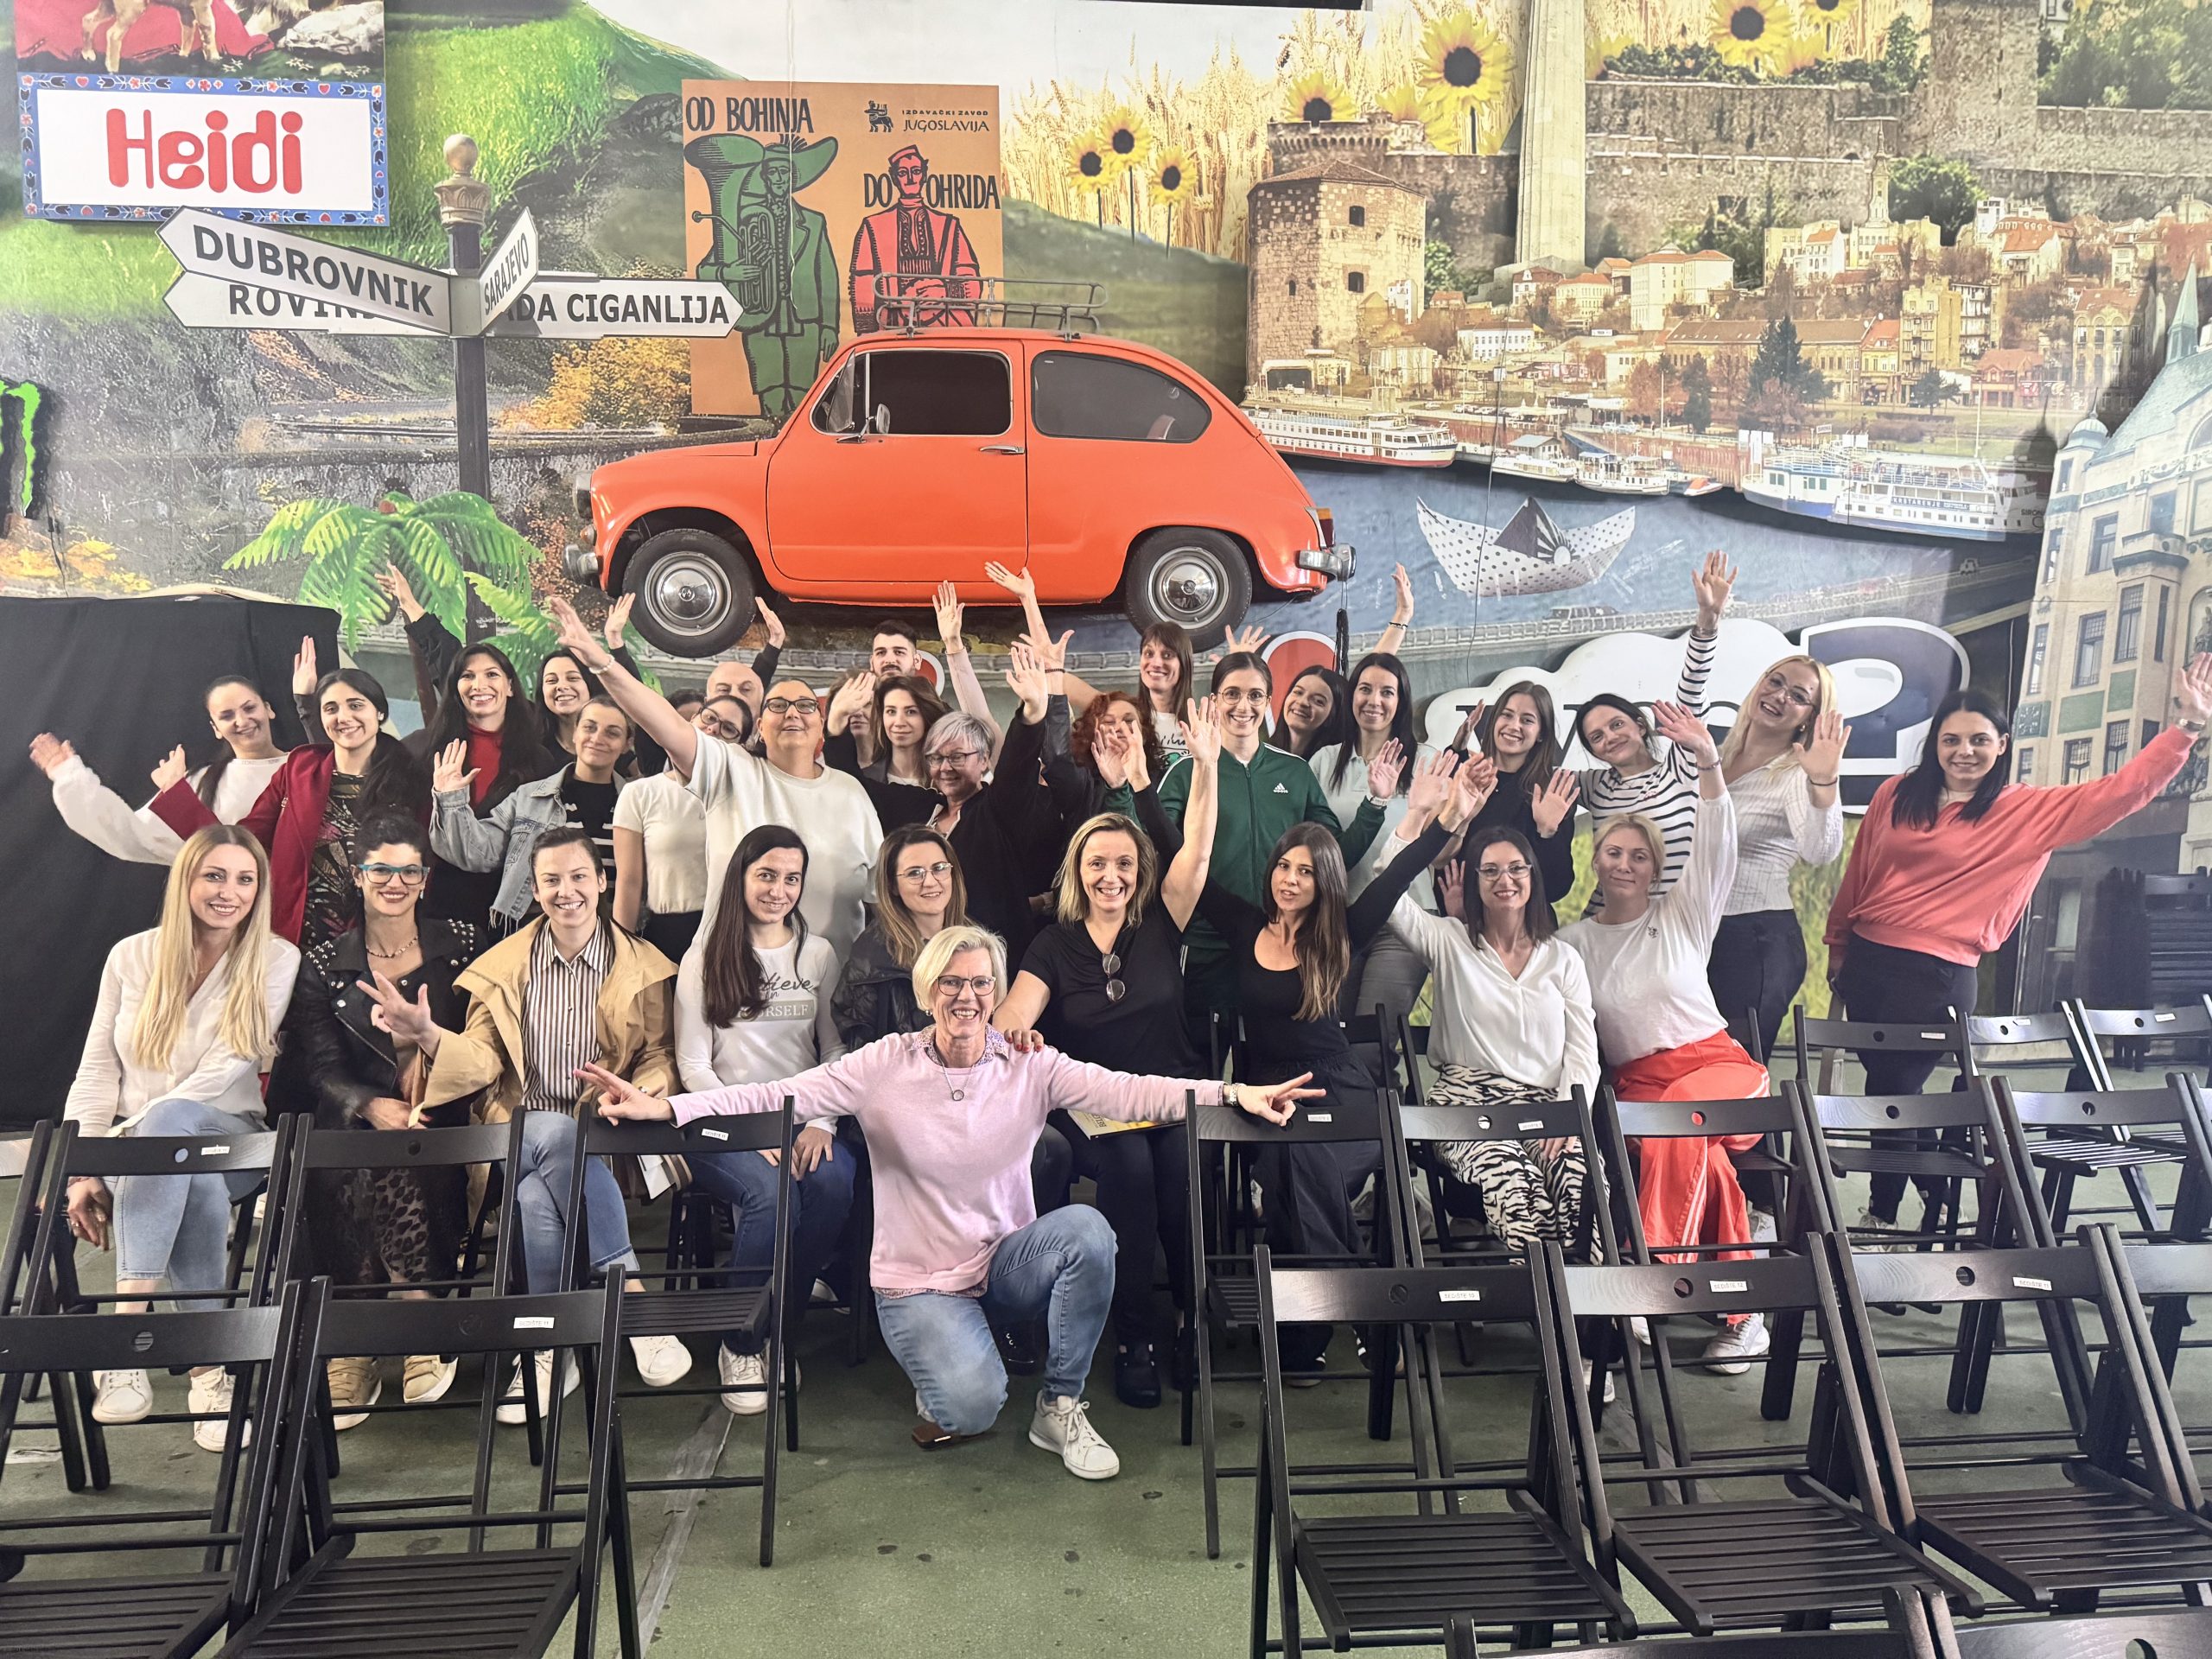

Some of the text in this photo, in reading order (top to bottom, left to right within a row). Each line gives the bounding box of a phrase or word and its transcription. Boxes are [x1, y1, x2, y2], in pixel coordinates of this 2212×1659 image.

[686, 97, 814, 133] OD BOHINJA
[904, 120, 990, 132] JUGOSLAVIJA
[106, 108, 302, 194] Heidi
[864, 173, 1001, 209] DO OHRIDA
[193, 224, 434, 317] DUBROVNIK
[484, 232, 529, 316] SARAJEVO
[567, 295, 729, 324] CIGANLIJA
